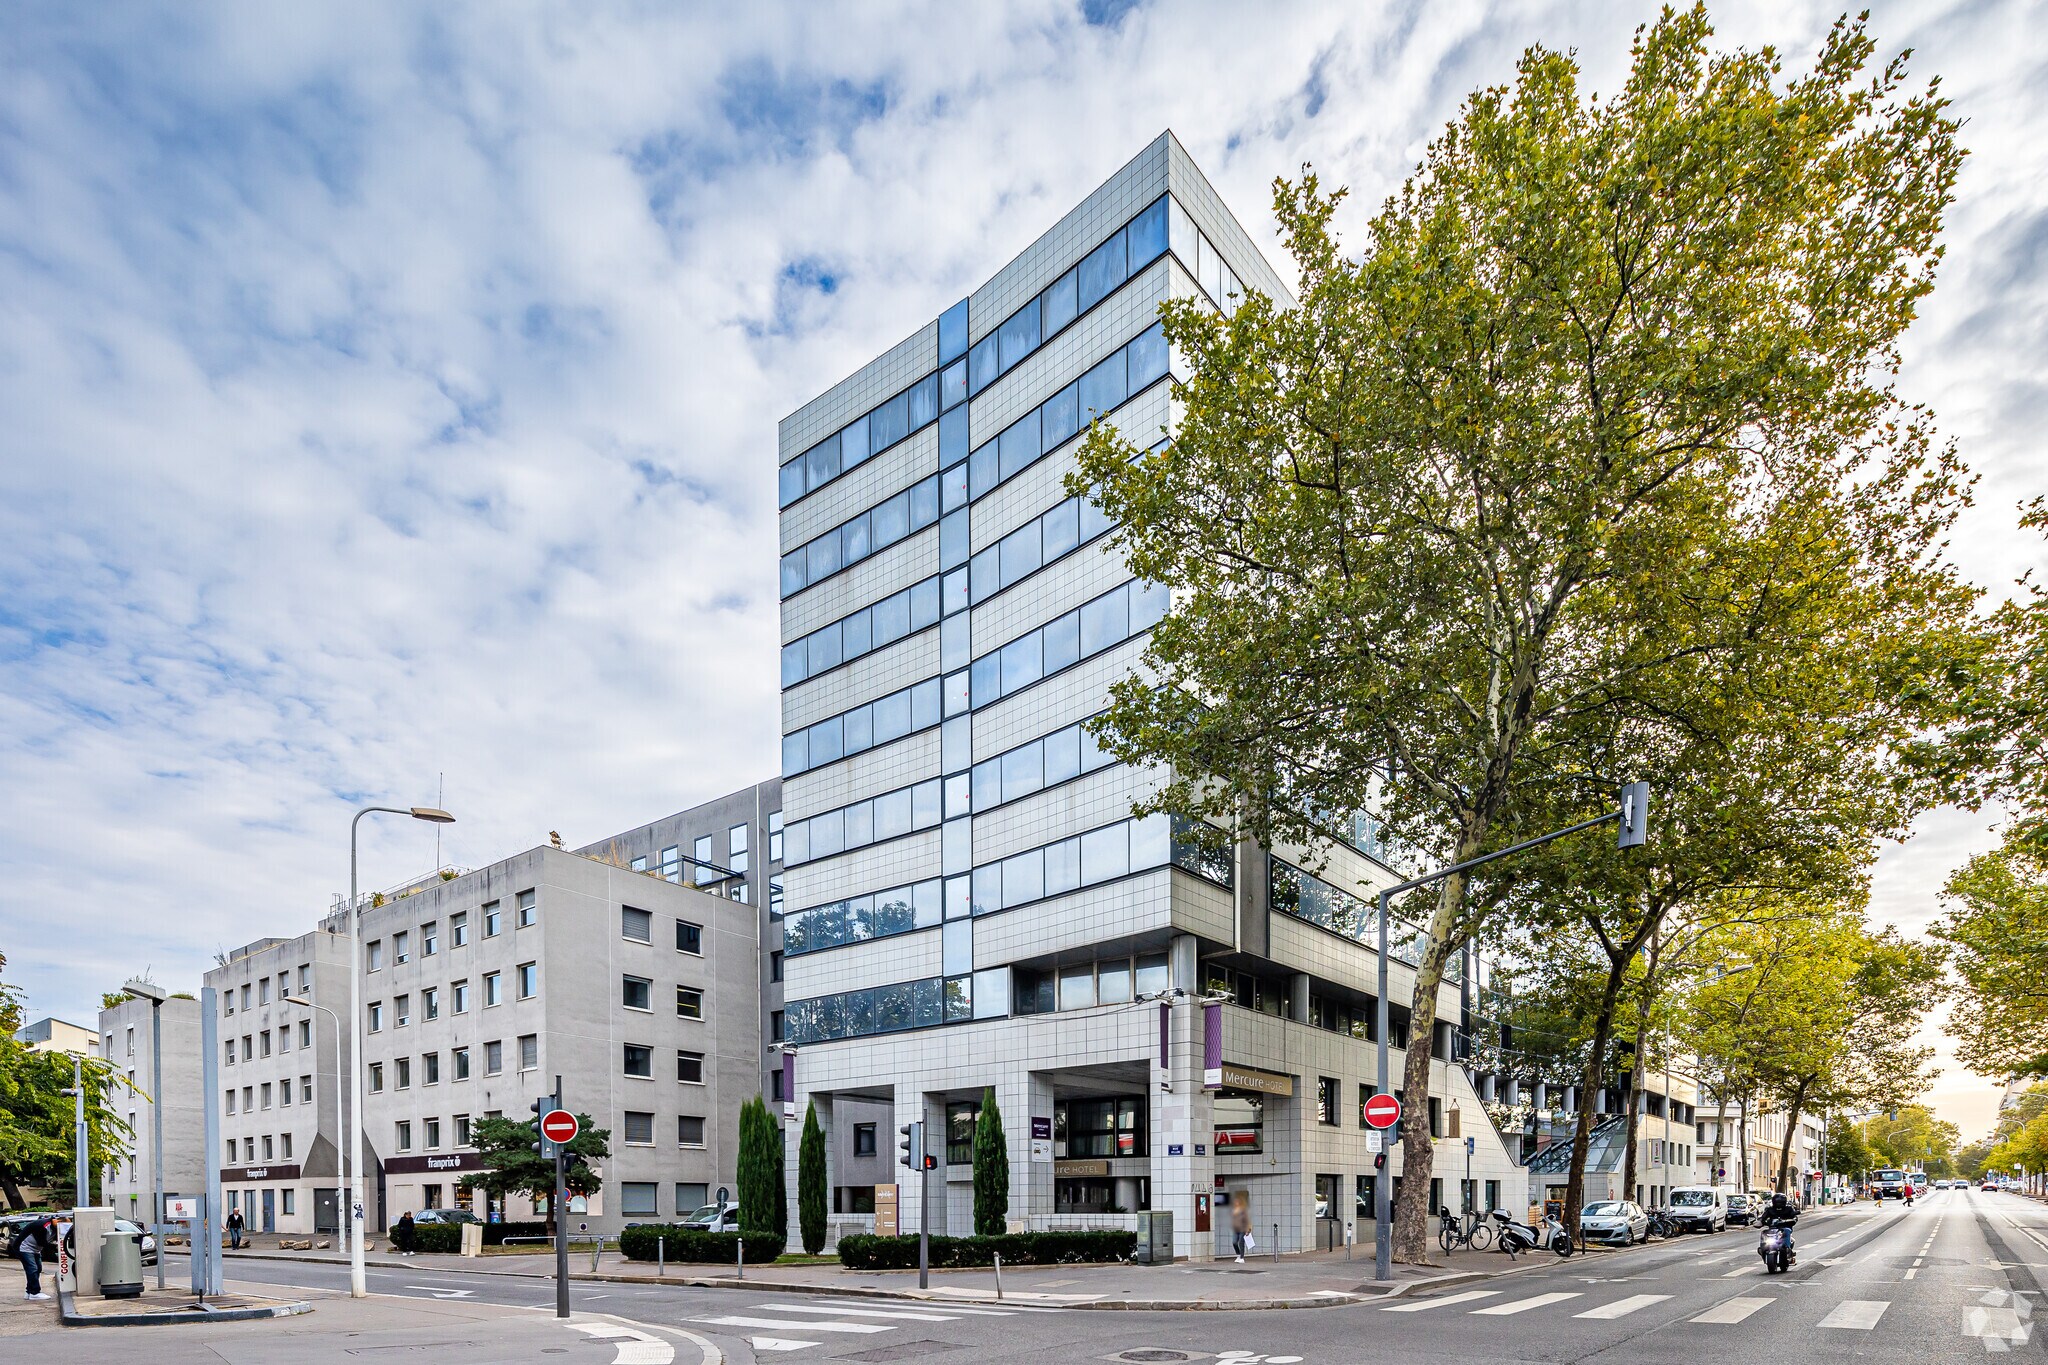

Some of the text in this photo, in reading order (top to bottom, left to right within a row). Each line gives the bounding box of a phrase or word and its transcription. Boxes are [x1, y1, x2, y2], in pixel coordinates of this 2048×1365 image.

[1225, 1071, 1264, 1088] Mercure
[427, 1156, 454, 1170] franprix
[1072, 1165, 1099, 1174] HOTEL
